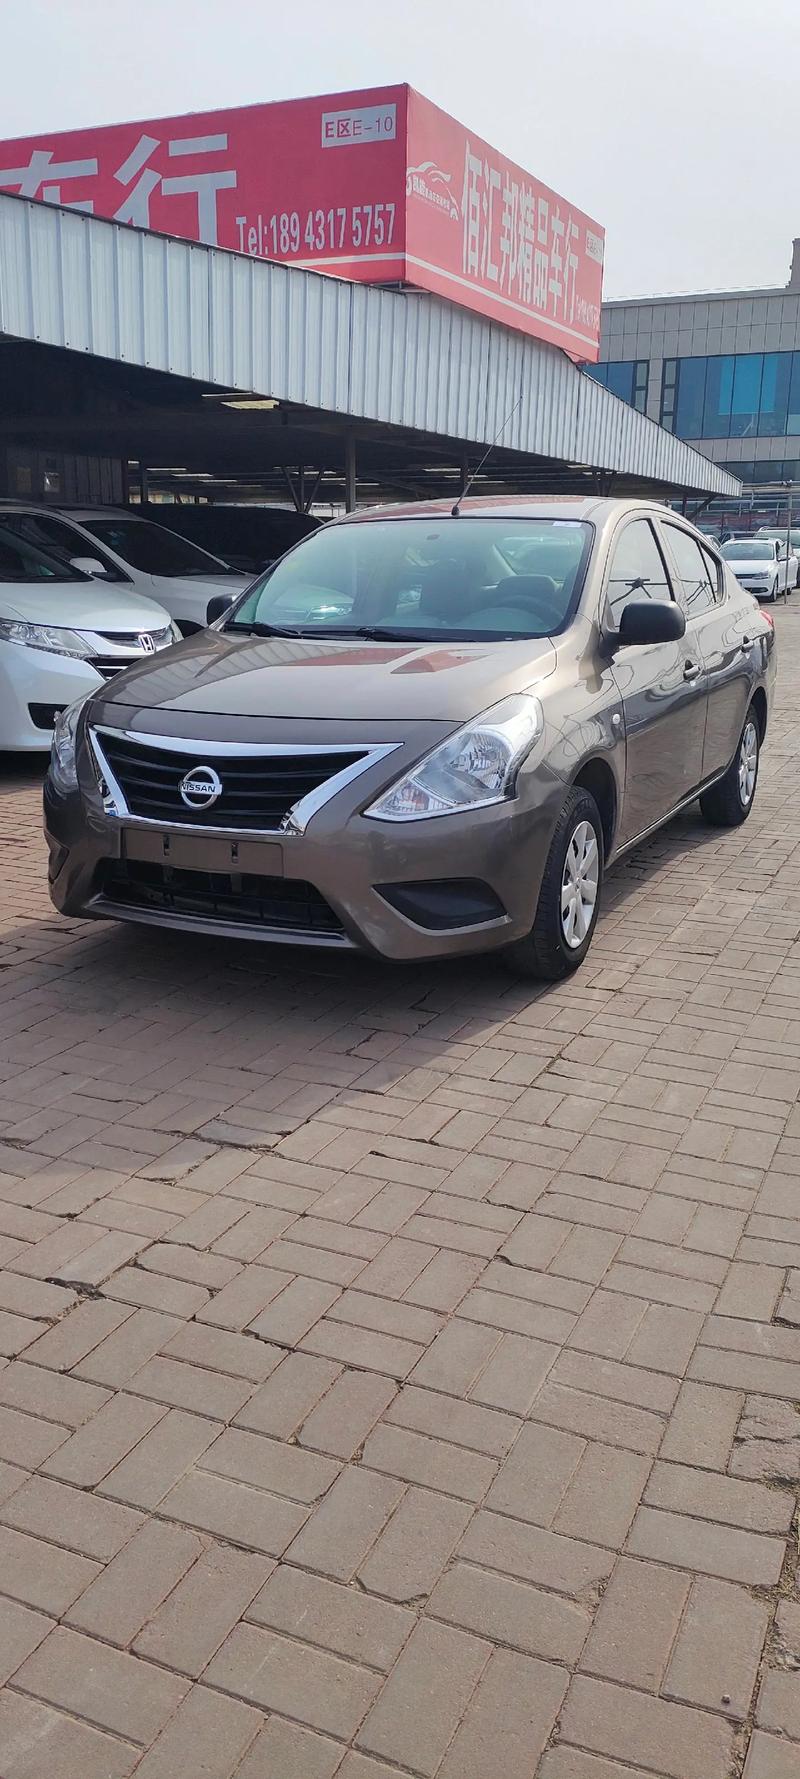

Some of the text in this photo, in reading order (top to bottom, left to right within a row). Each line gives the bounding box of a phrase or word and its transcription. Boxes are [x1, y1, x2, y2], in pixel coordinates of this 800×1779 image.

[304, 208, 347, 251] 4317
[352, 203, 396, 247] 5757
[461, 139, 579, 324] 佰汇邦精品车行
[179, 780, 216, 793] NISSAN
